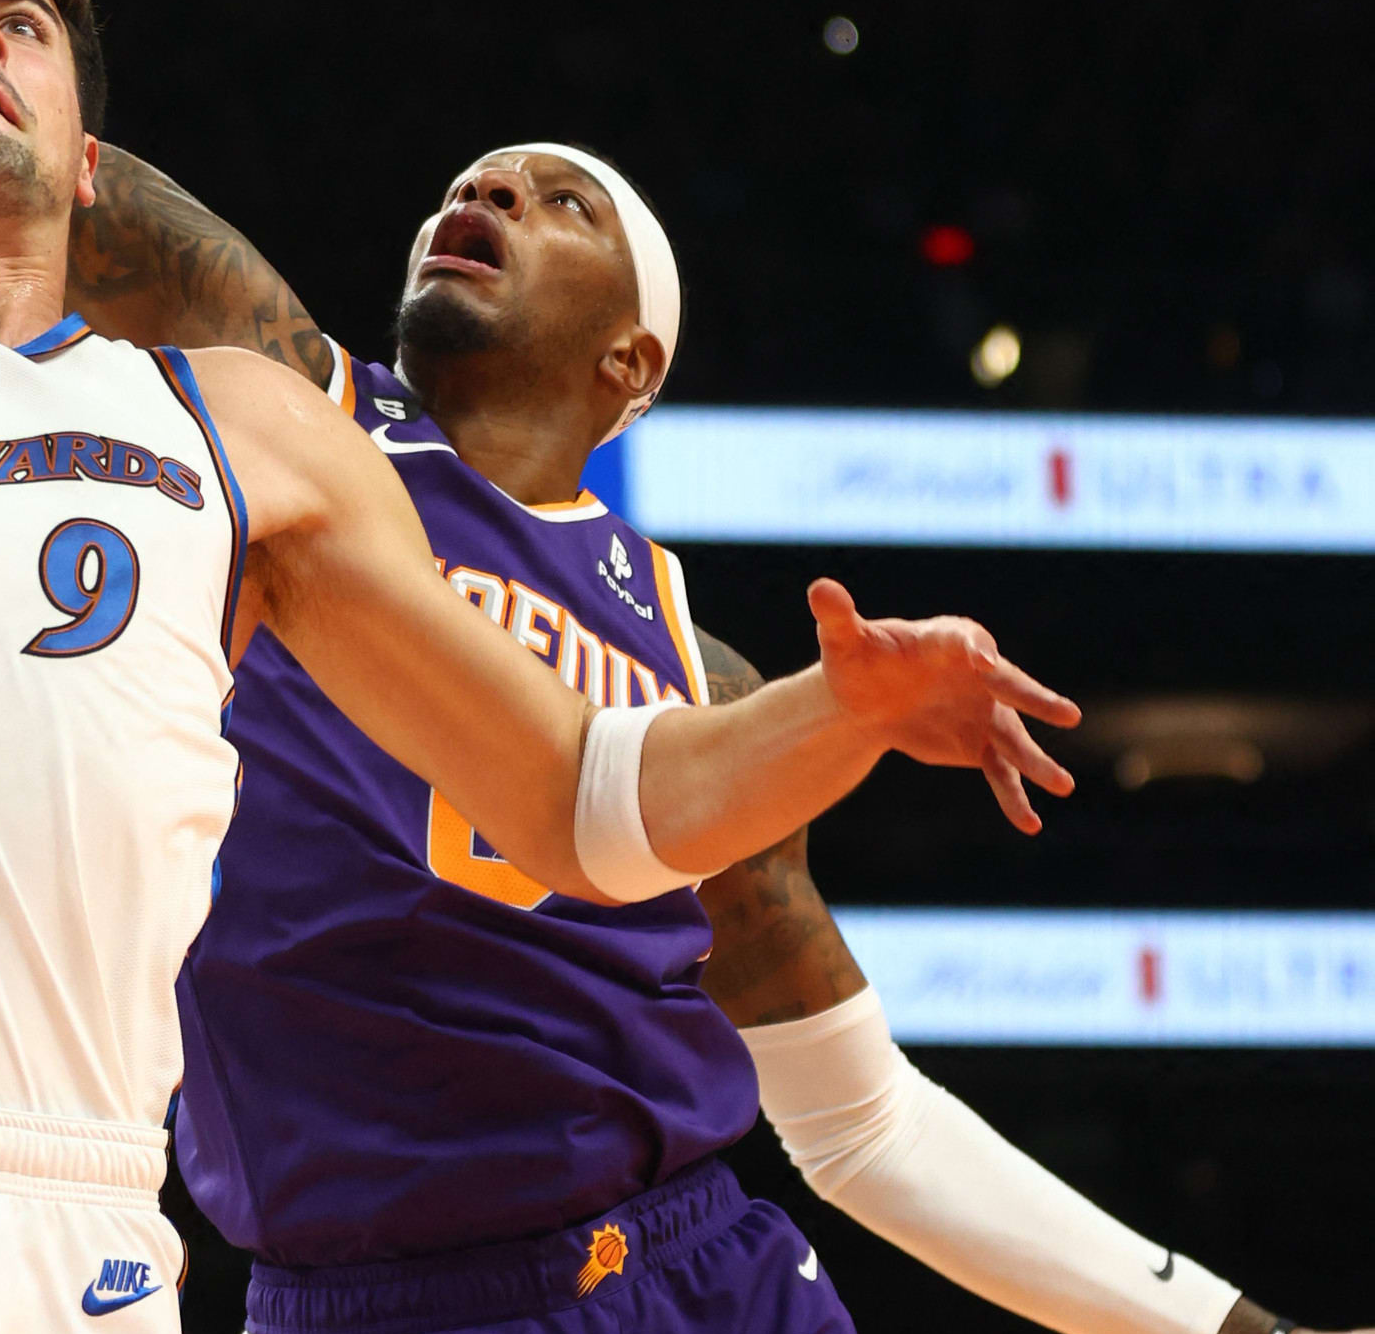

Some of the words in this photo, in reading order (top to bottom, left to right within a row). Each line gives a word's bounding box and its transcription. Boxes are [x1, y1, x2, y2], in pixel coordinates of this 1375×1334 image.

[20, 517, 141, 659] 9
[597, 559, 654, 621] PayPal
[96, 1258, 151, 1293] NIKE
